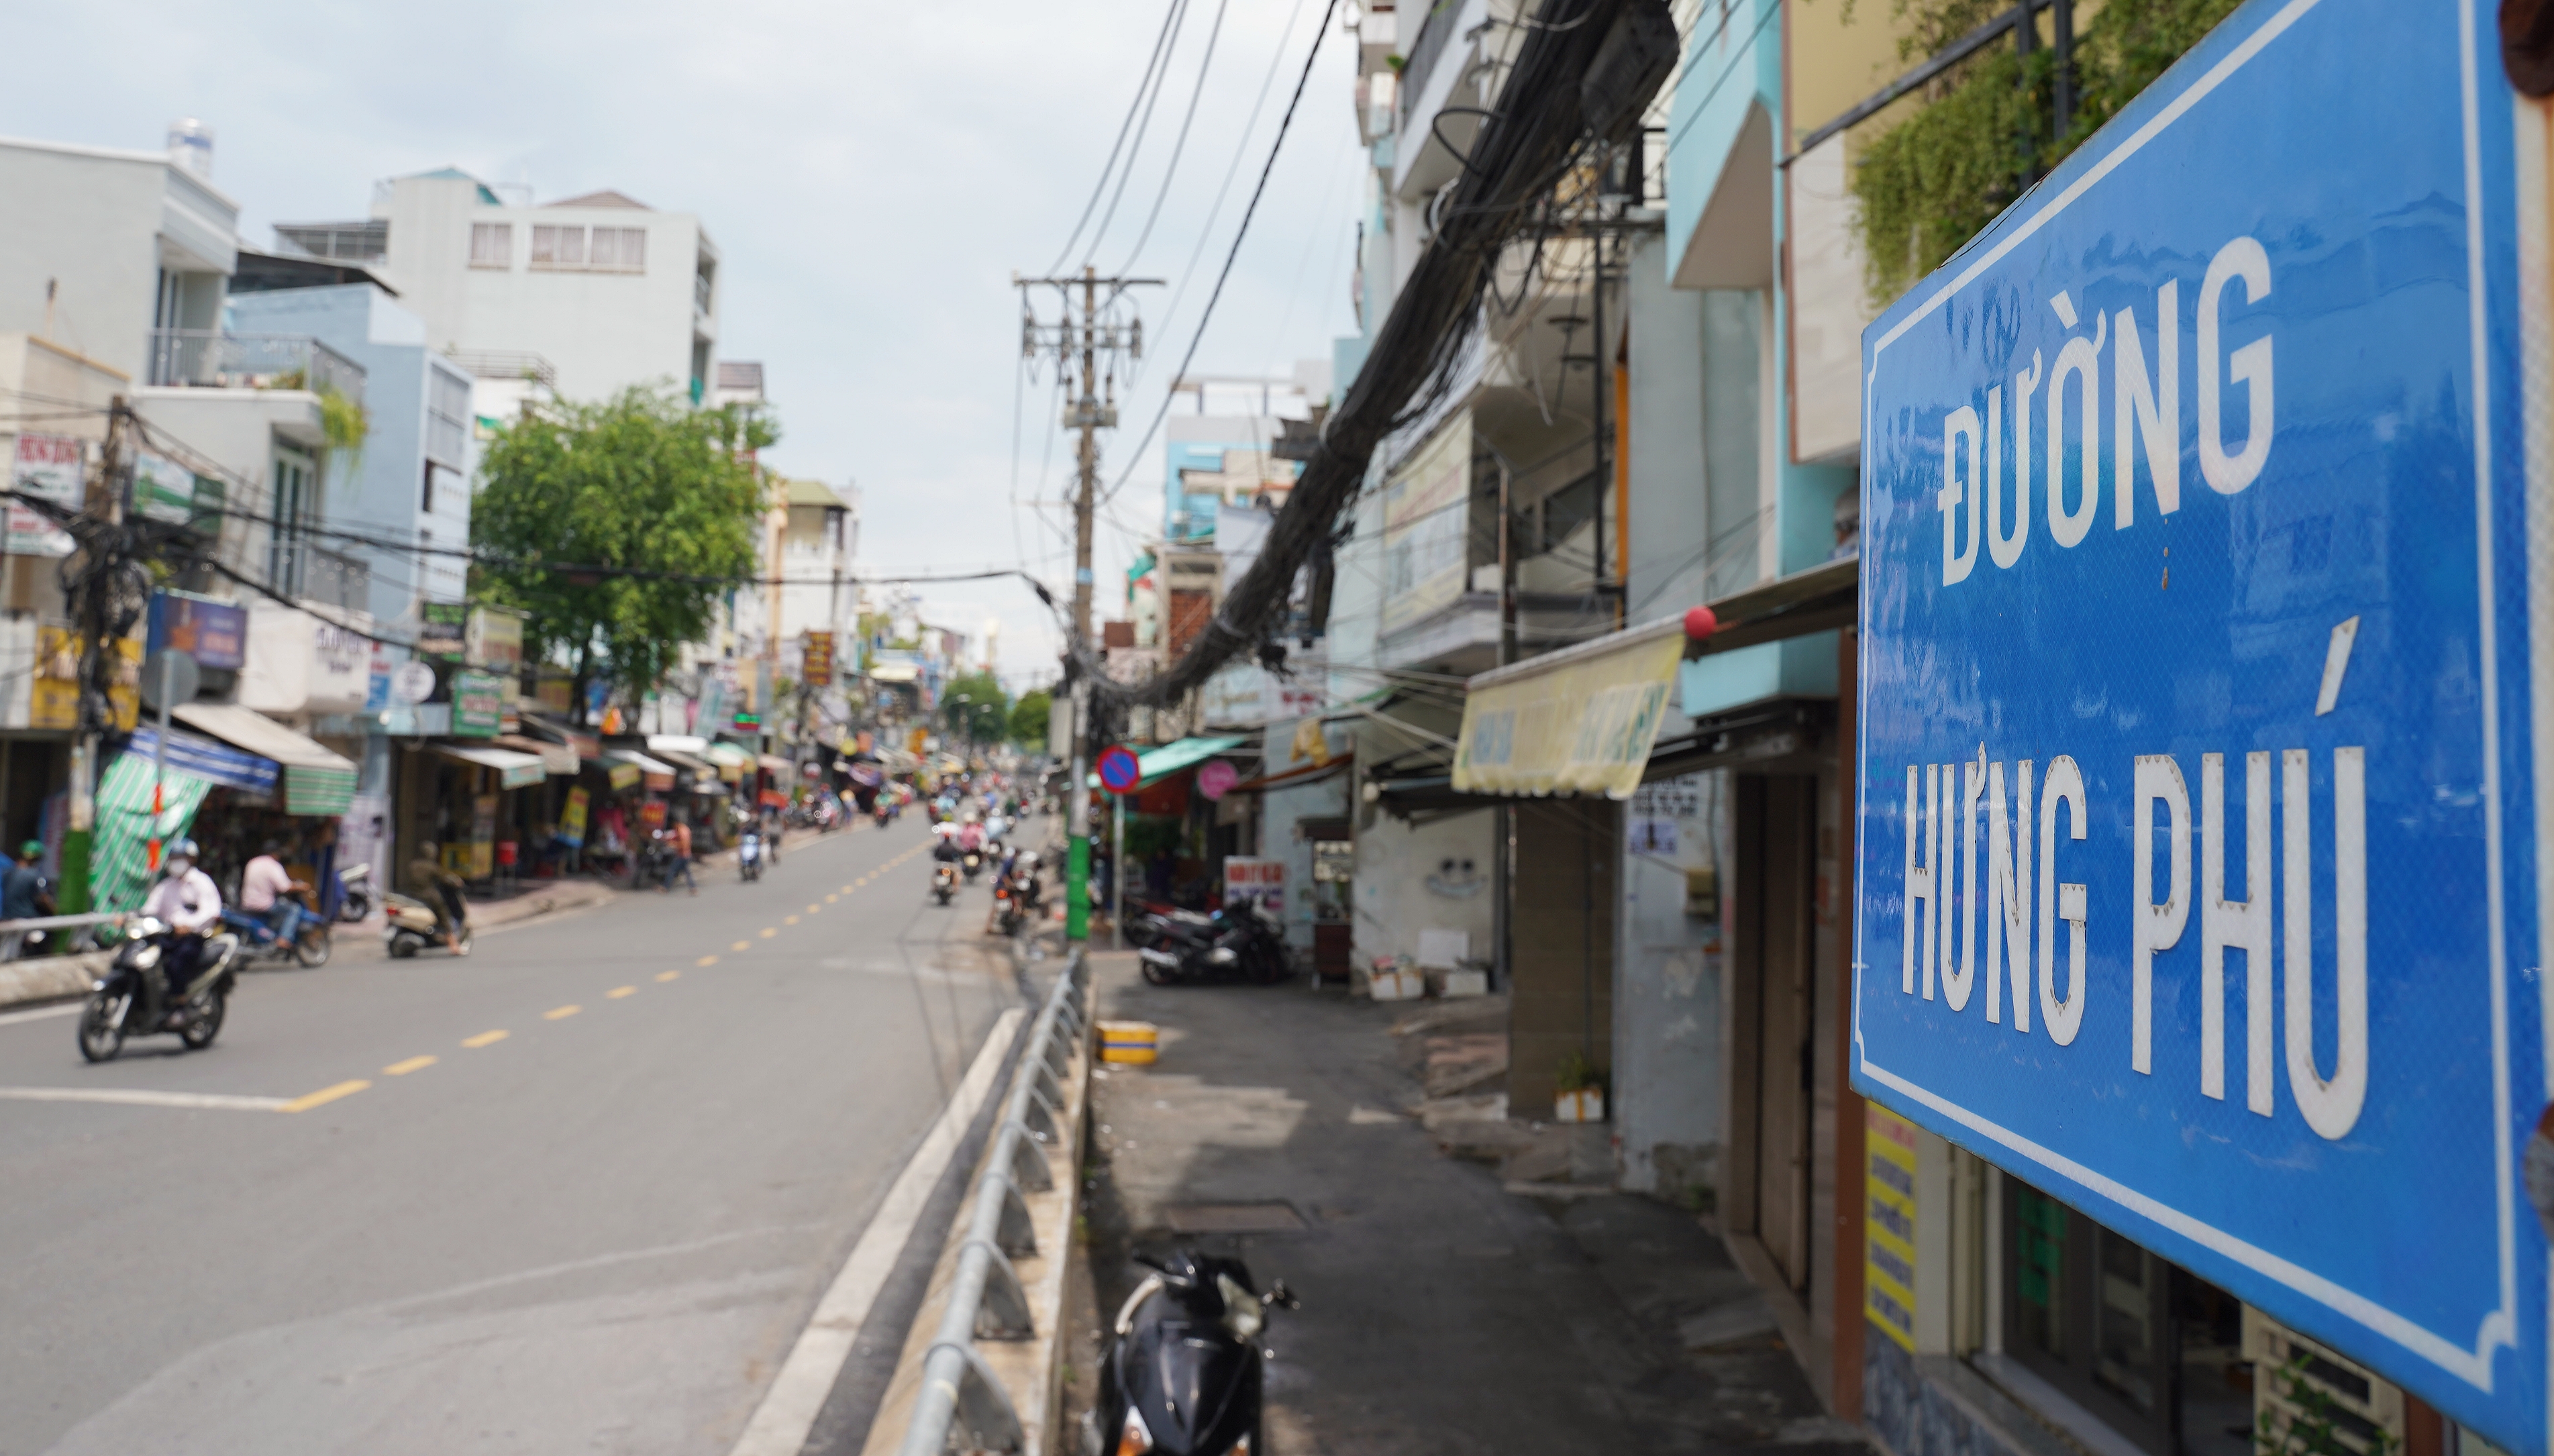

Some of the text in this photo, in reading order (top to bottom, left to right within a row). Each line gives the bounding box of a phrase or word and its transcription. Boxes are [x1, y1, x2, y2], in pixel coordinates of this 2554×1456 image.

[1937, 236, 2275, 587] ĐƯỜNG
[1902, 615, 2369, 1141] HƯNG PHÚ
